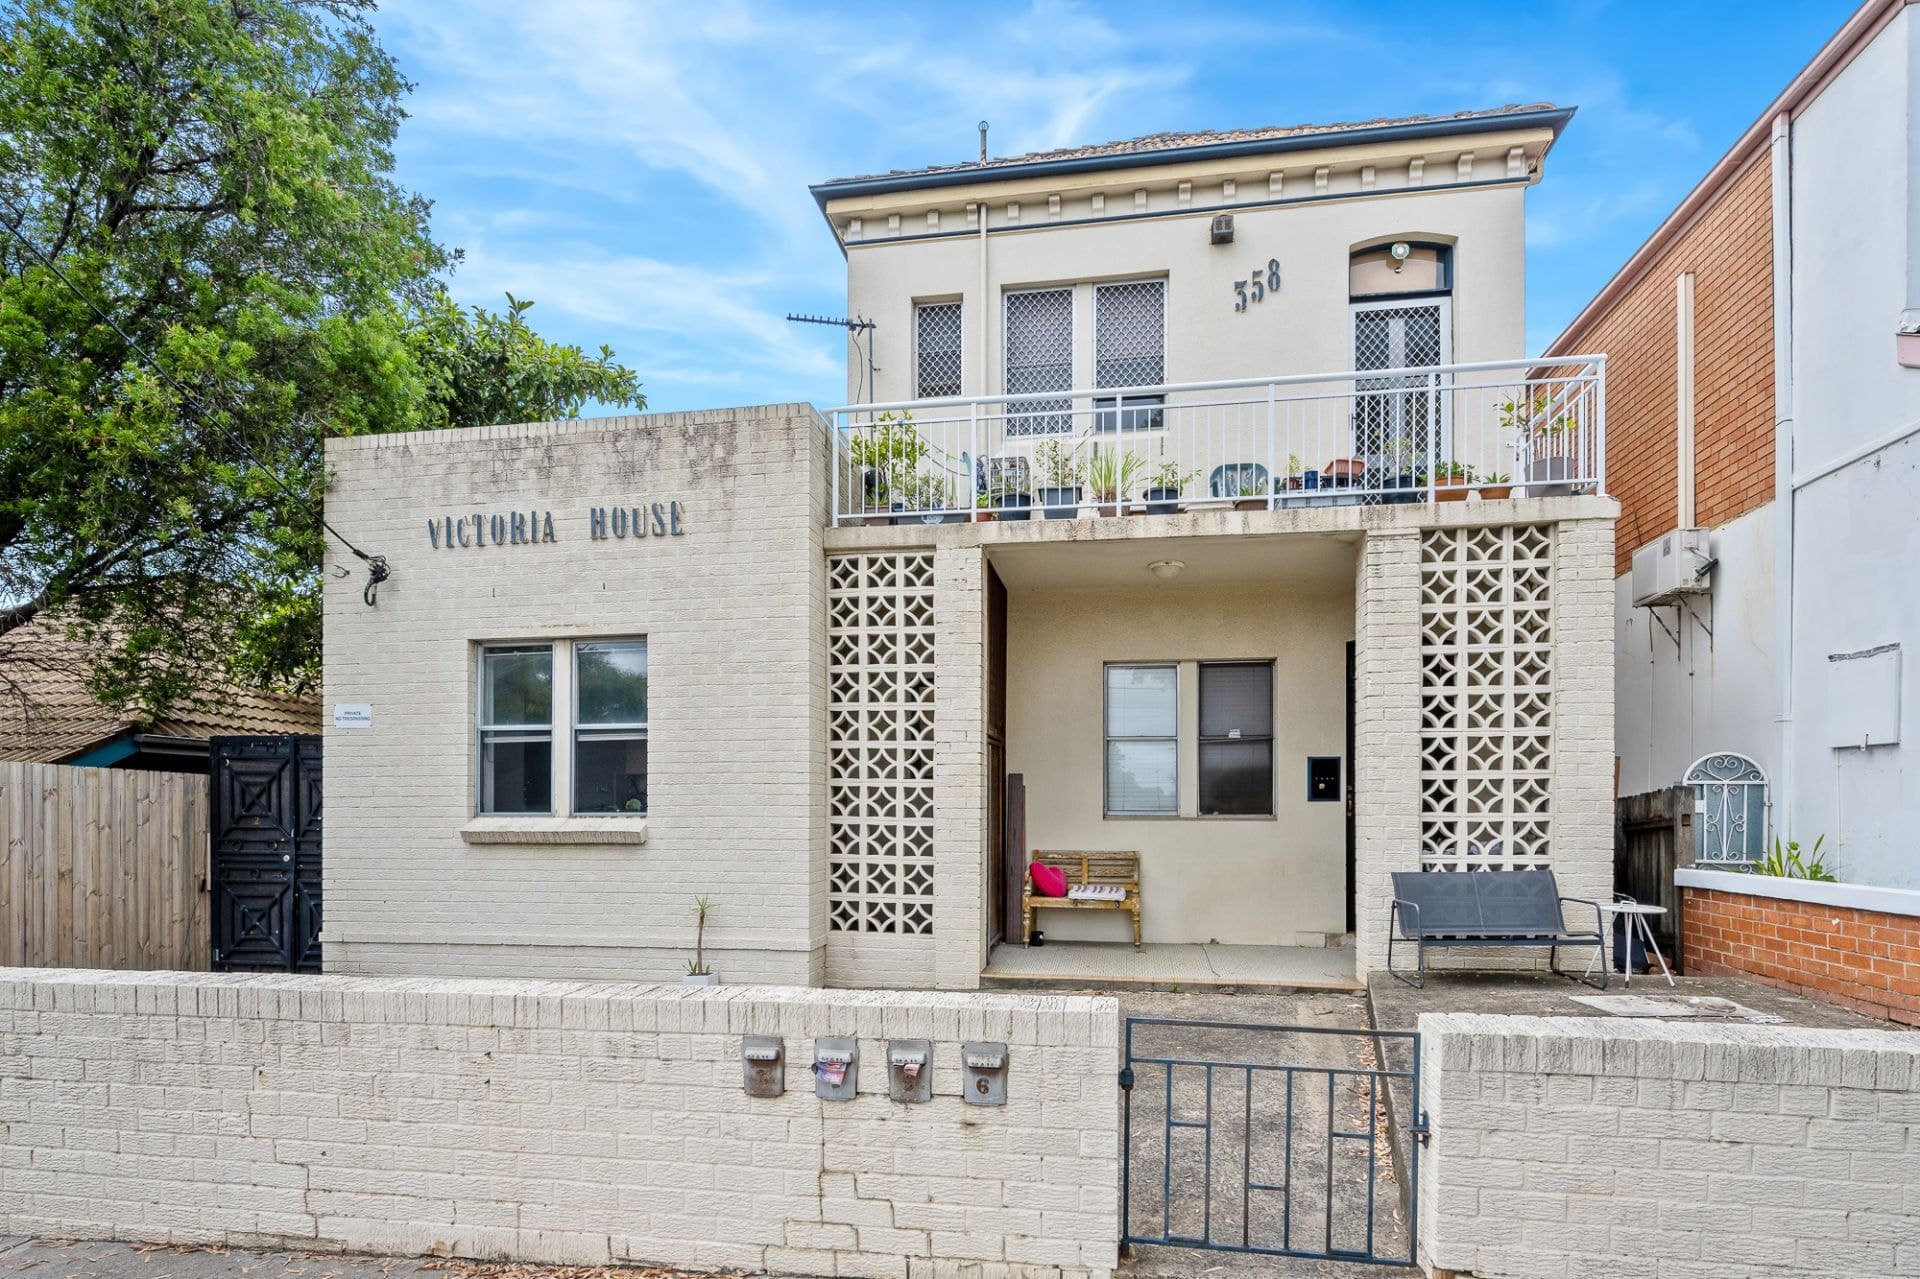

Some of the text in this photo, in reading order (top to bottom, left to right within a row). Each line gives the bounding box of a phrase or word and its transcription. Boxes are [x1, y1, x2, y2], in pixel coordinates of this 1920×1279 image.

[1234, 258, 1280, 313] 358
[427, 500, 685, 549] VICTORIA HOUSE
[976, 1077, 990, 1095] 6
